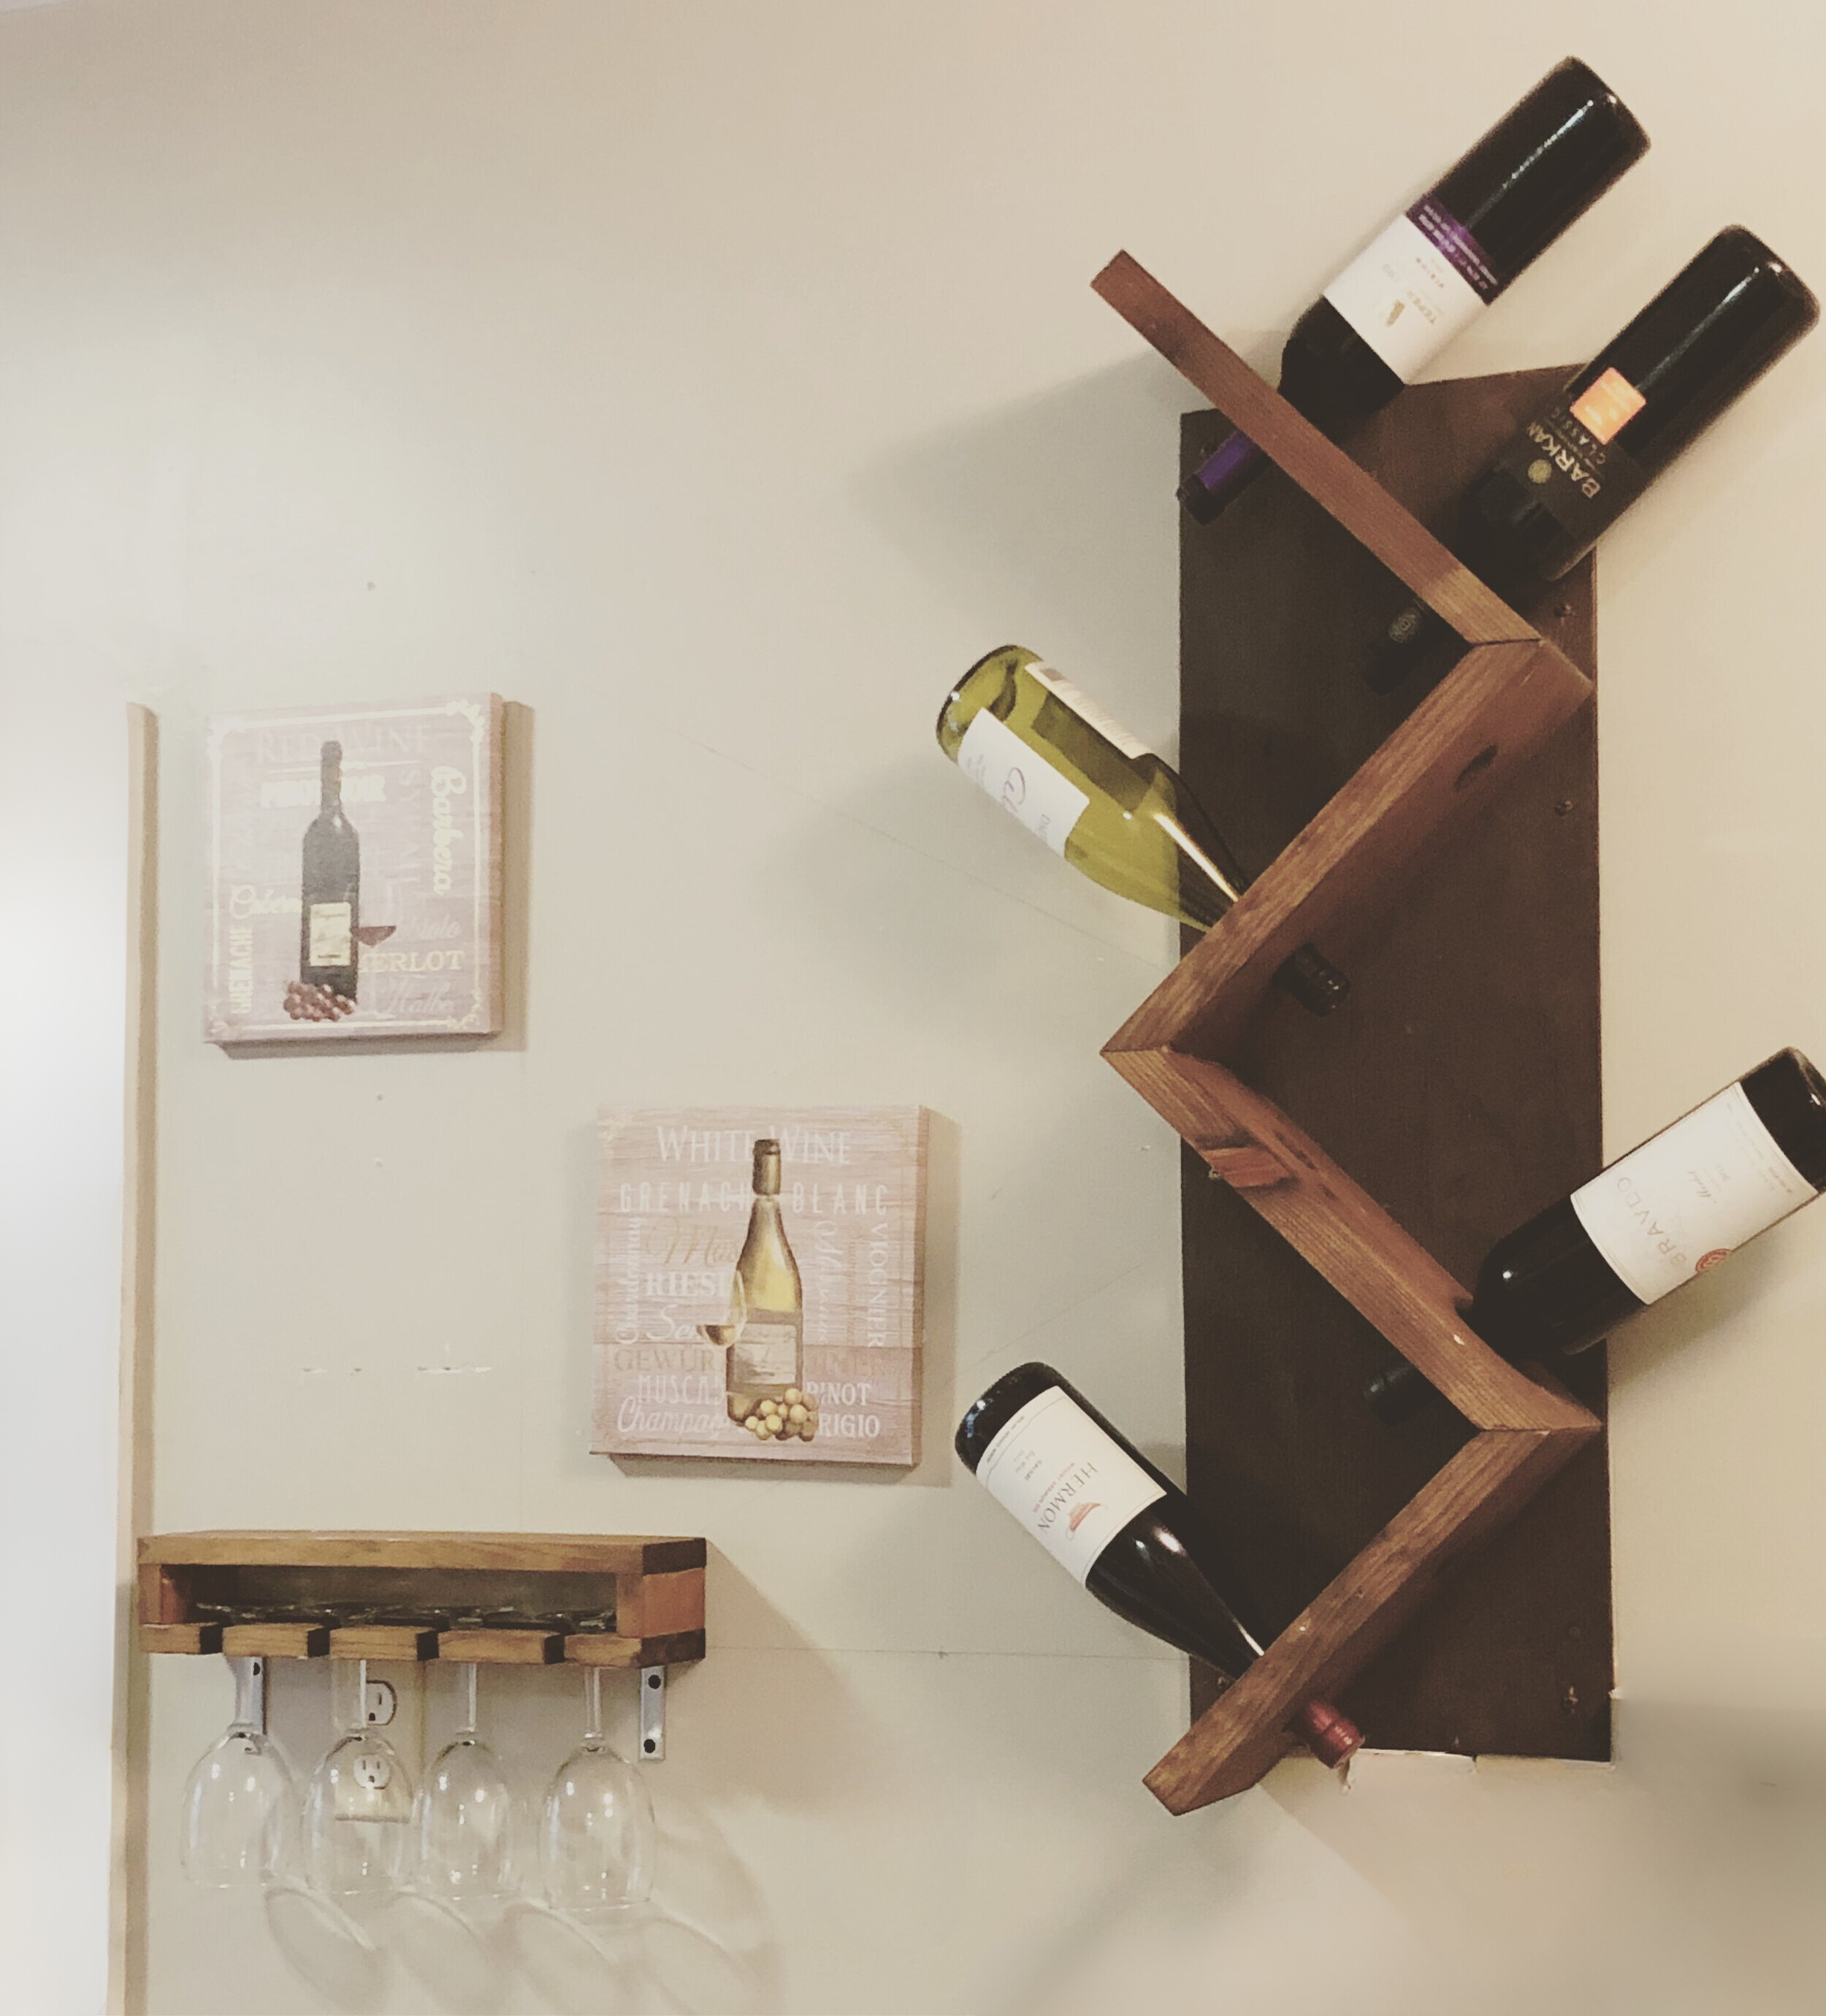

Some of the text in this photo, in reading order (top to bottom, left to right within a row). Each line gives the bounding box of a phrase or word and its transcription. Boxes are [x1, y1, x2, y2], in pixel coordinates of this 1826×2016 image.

[1524, 420, 1602, 499] BARKAN
[340, 775, 387, 804] OIR
[429, 765, 467, 896] Barbera
[657, 1125, 852, 1165] WHITE WINE
[619, 1182, 889, 1215] GRENACH BLANC
[867, 1221, 888, 1348] VIOGNIER
[820, 1414, 881, 1439] RIGIO
[1037, 1462, 1099, 1533] HERMON
